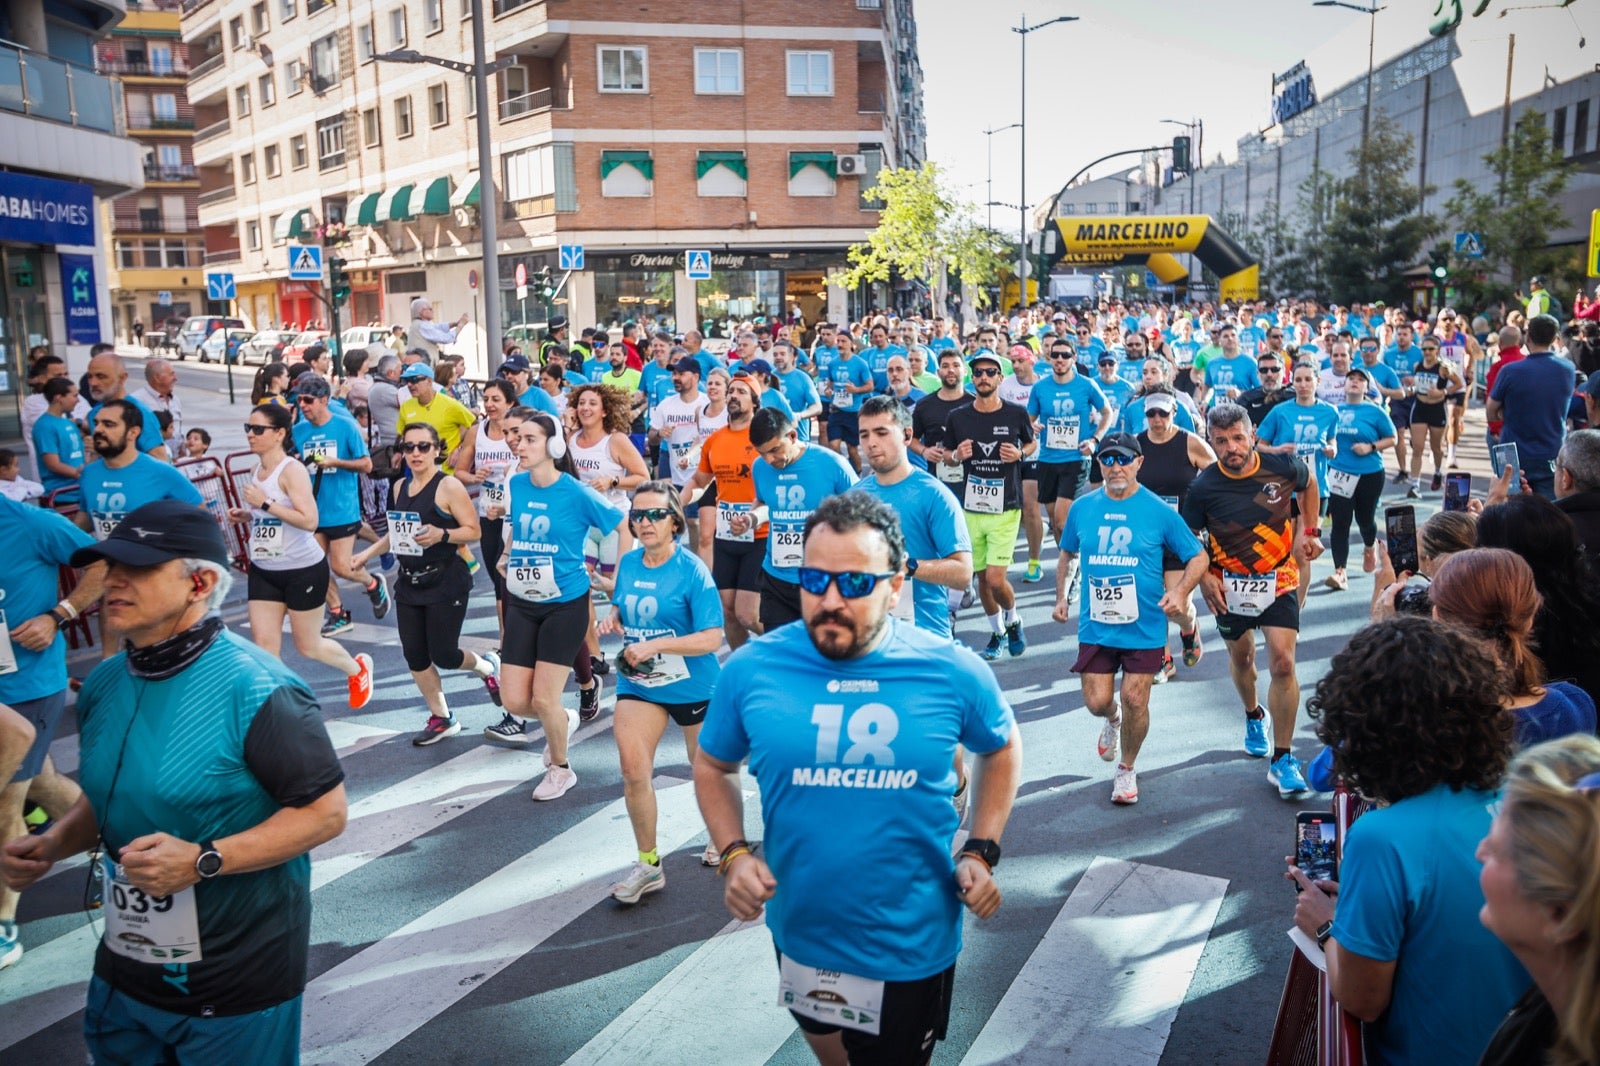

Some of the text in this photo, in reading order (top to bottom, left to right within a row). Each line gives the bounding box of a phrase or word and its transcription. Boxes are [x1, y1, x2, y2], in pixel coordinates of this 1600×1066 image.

[1075, 222, 1189, 241] MARCELINO
[1052, 426, 1075, 436] 1975
[1293, 423, 1319, 442] 18
[776, 485, 806, 510] 18
[972, 485, 998, 497] 1970
[395, 521, 413, 534] 617
[518, 513, 550, 542] 18
[512, 540, 559, 554] MARCELINO
[1097, 526, 1133, 555] 18
[1088, 555, 1139, 567] MARCELINO
[516, 567, 541, 581] 676
[1095, 587, 1123, 601] 825
[1231, 579, 1268, 593] 1722
[624, 594, 658, 627] 18
[810, 702, 899, 766] 18
[791, 767, 918, 789] MARCELINO
[112, 884, 174, 914] 039
